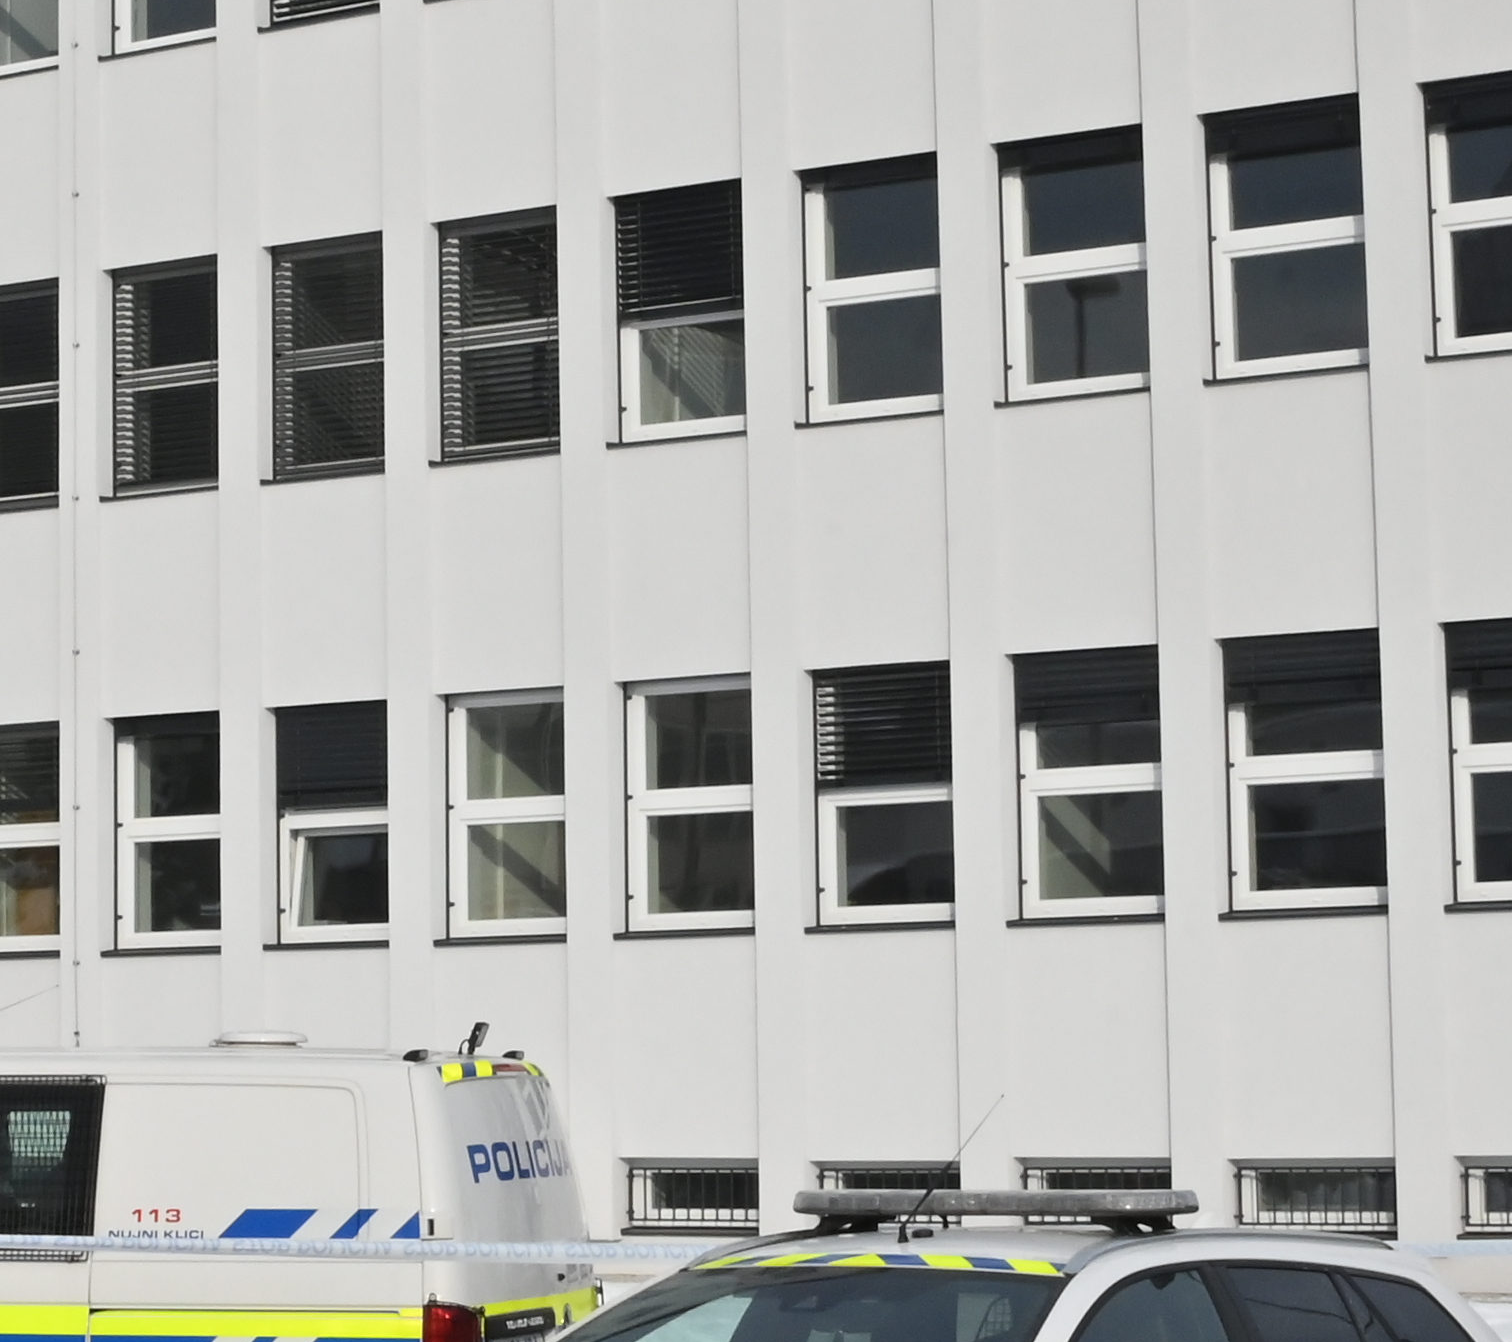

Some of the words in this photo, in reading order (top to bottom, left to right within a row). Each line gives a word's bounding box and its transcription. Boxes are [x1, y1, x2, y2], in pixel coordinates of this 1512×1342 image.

[466, 1139, 573, 1183] POLICIJA
[132, 1209, 181, 1223] 113
[108, 1230, 158, 1239] NUJNI
[163, 1230, 204, 1239] KLICI
